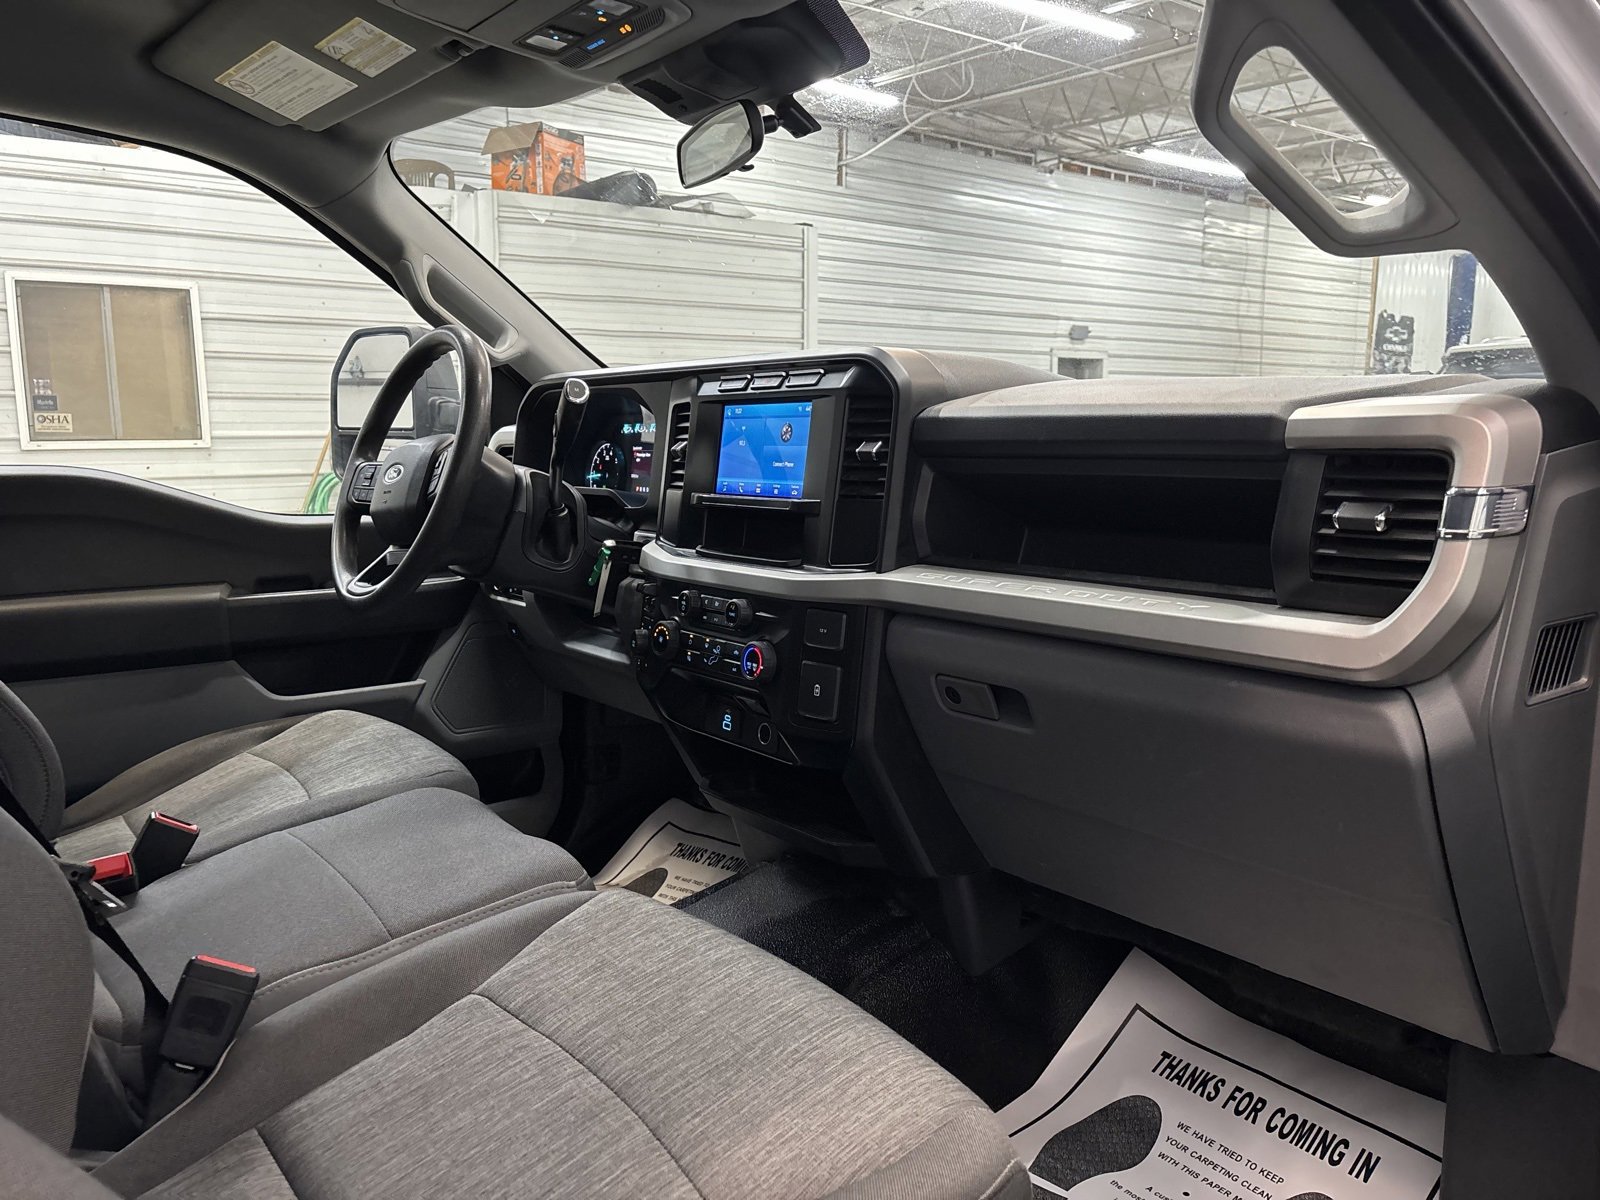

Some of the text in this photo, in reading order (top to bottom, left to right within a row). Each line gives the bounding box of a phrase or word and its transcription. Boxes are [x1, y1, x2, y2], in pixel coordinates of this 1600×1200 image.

[37, 414, 69, 424] OSHA
[917, 571, 1212, 612] SUPER DUTY
[669, 842, 708, 864] THANKS
[702, 851, 727, 868] FOR
[1151, 1050, 1382, 1184] THANKS FOR COMING IN
[1157, 1151, 1179, 1168] WITH
[1180, 1164, 1200, 1179] THIS
[1201, 1177, 1232, 1198] PAPER
[1165, 1135, 1273, 1200] YOUR CARPETING CLEAN
[1176, 1121, 1285, 1185] WE HAVE TRIED TO KEEP
[1110, 1180, 1123, 1190] the
